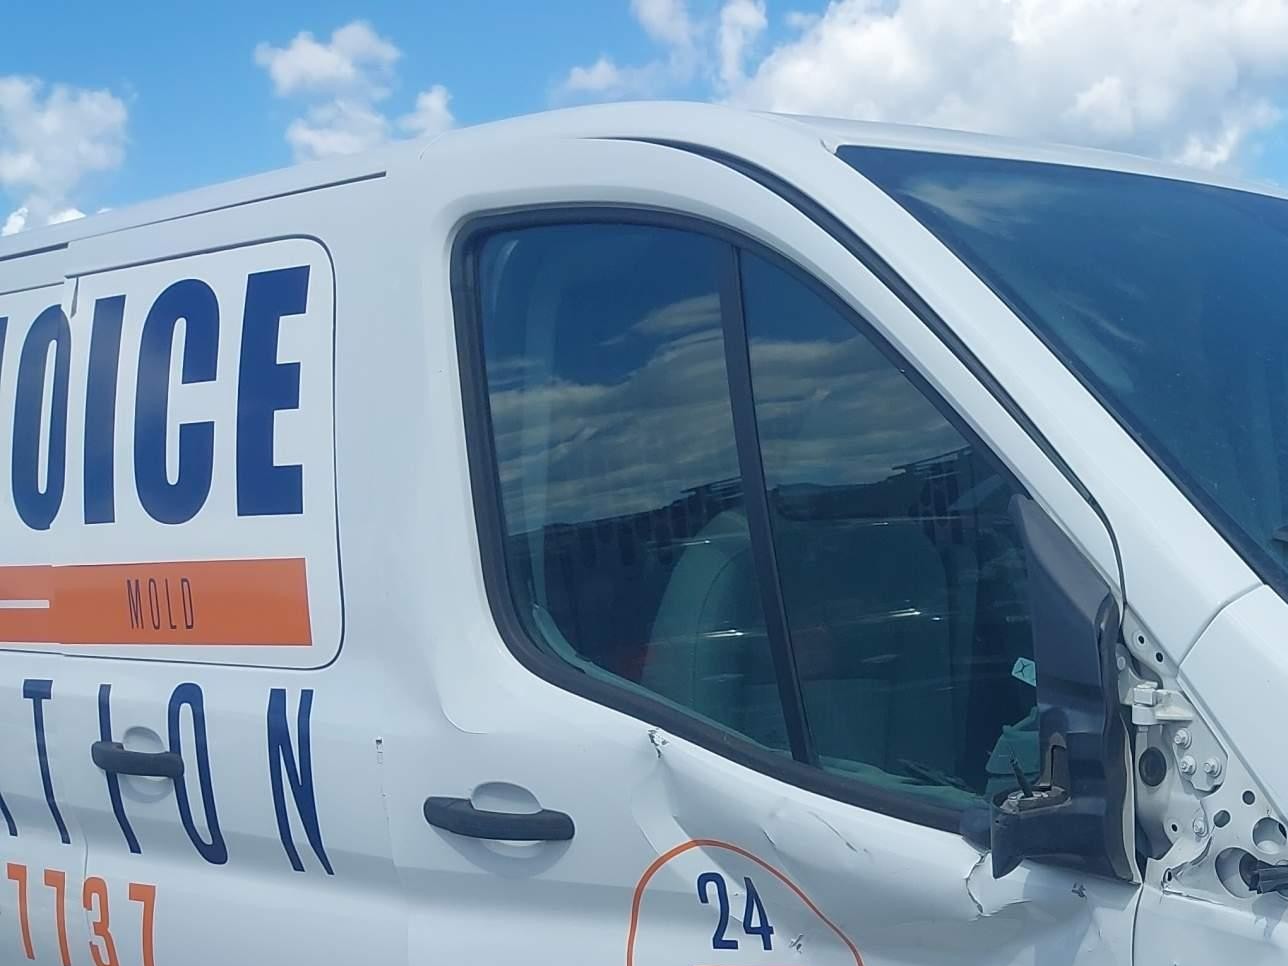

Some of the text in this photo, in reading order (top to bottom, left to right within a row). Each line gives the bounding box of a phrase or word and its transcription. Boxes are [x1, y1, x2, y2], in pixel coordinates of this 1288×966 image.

[0, 265, 310, 531] OICE
[126, 577, 195, 631] MOLD
[0, 679, 334, 875] TION
[697, 872, 774, 950] 24
